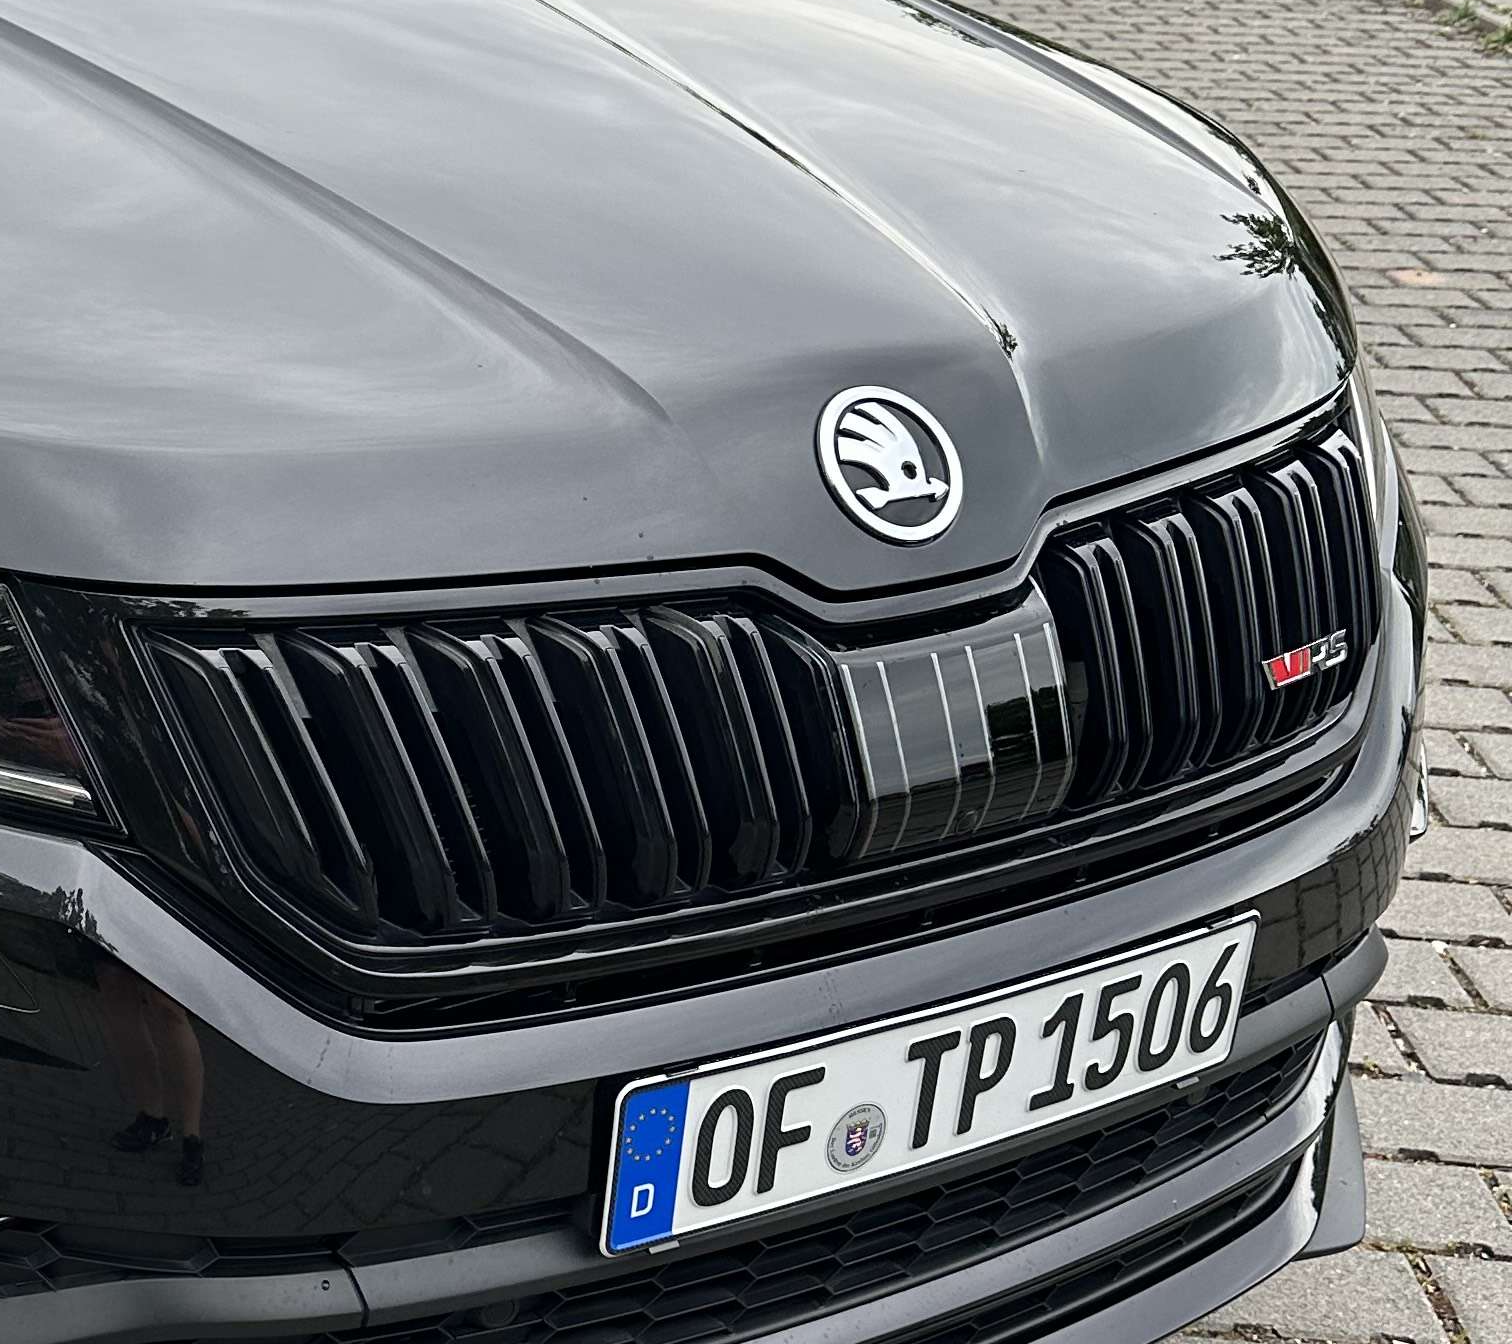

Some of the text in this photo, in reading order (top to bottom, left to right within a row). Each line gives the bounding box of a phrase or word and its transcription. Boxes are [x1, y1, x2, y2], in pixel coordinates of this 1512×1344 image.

[690, 941, 1239, 1208] OF TP 1506
[630, 1183, 655, 1218] D
